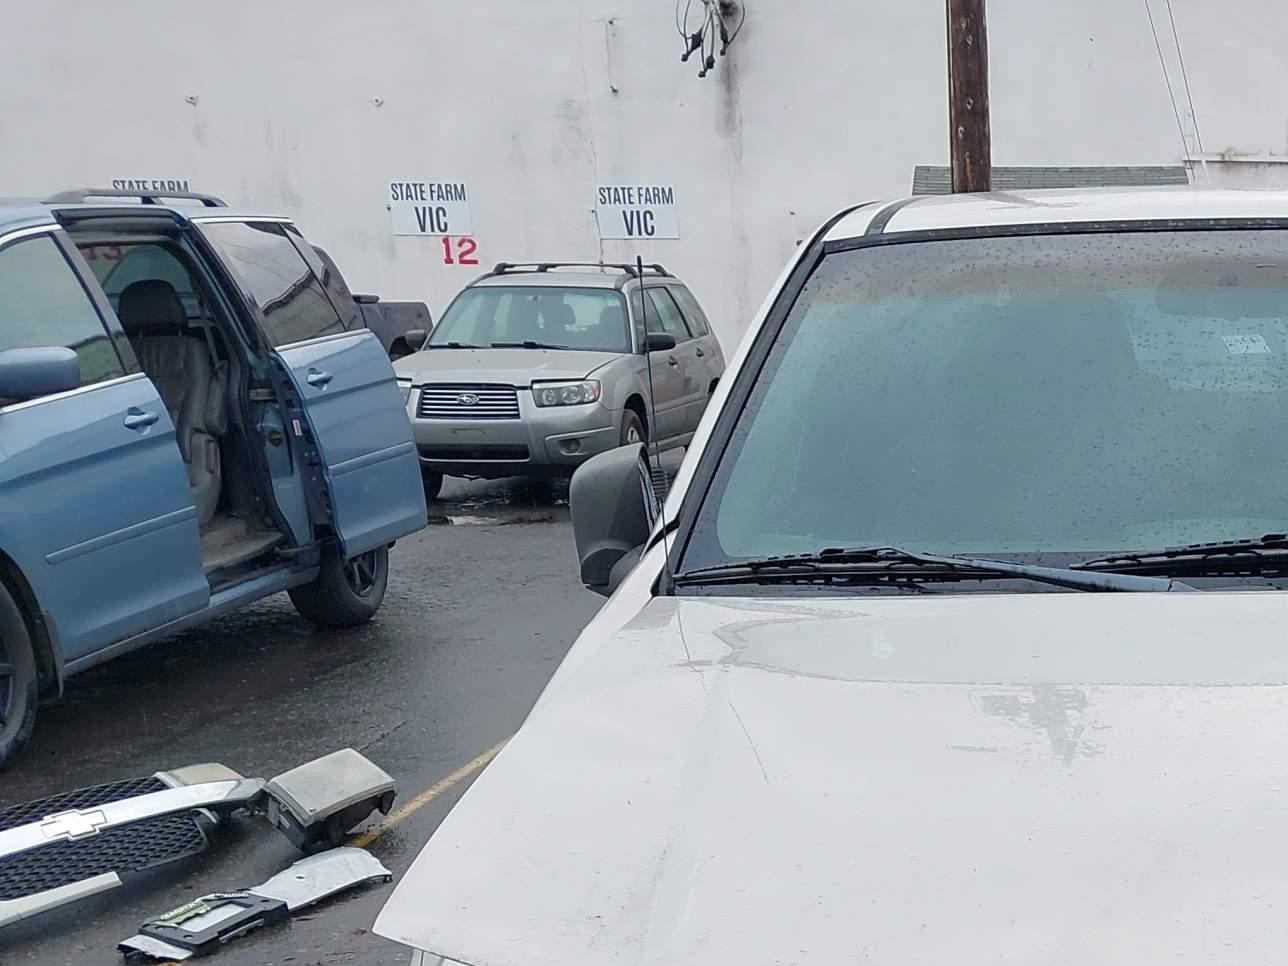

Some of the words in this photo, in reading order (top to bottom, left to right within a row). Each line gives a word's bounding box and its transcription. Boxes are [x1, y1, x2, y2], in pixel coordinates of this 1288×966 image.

[112, 179, 148, 192] STATE
[152, 180, 189, 193] FARM
[391, 183, 427, 201] STATE
[429, 183, 467, 202] FARM
[598, 186, 635, 205] STATE
[636, 186, 674, 205] FARM
[414, 206, 449, 233] VIC
[622, 209, 655, 236] VIC
[442, 237, 479, 265] 12
